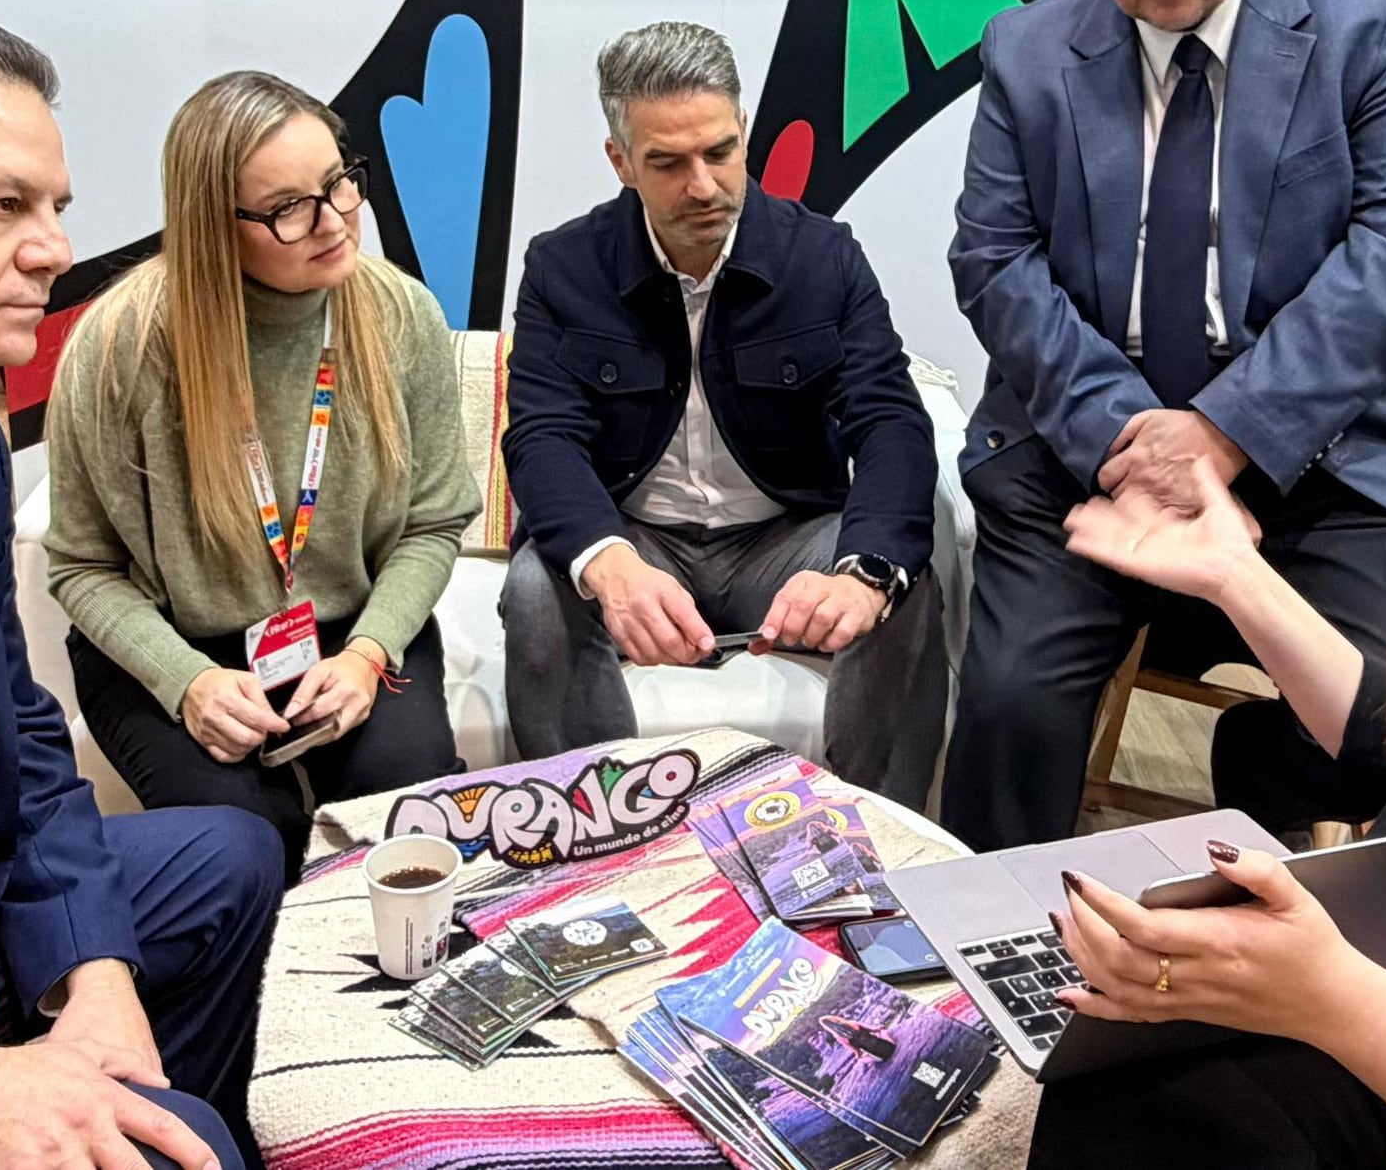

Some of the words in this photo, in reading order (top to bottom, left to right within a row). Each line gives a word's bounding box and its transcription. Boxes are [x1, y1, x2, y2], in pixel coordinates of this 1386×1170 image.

[392, 753, 696, 858] DURANGO
[573, 845, 593, 856] Un
[595, 833, 641, 853] mundo
[643, 826, 660, 837] de
[661, 805, 686, 828] cine
